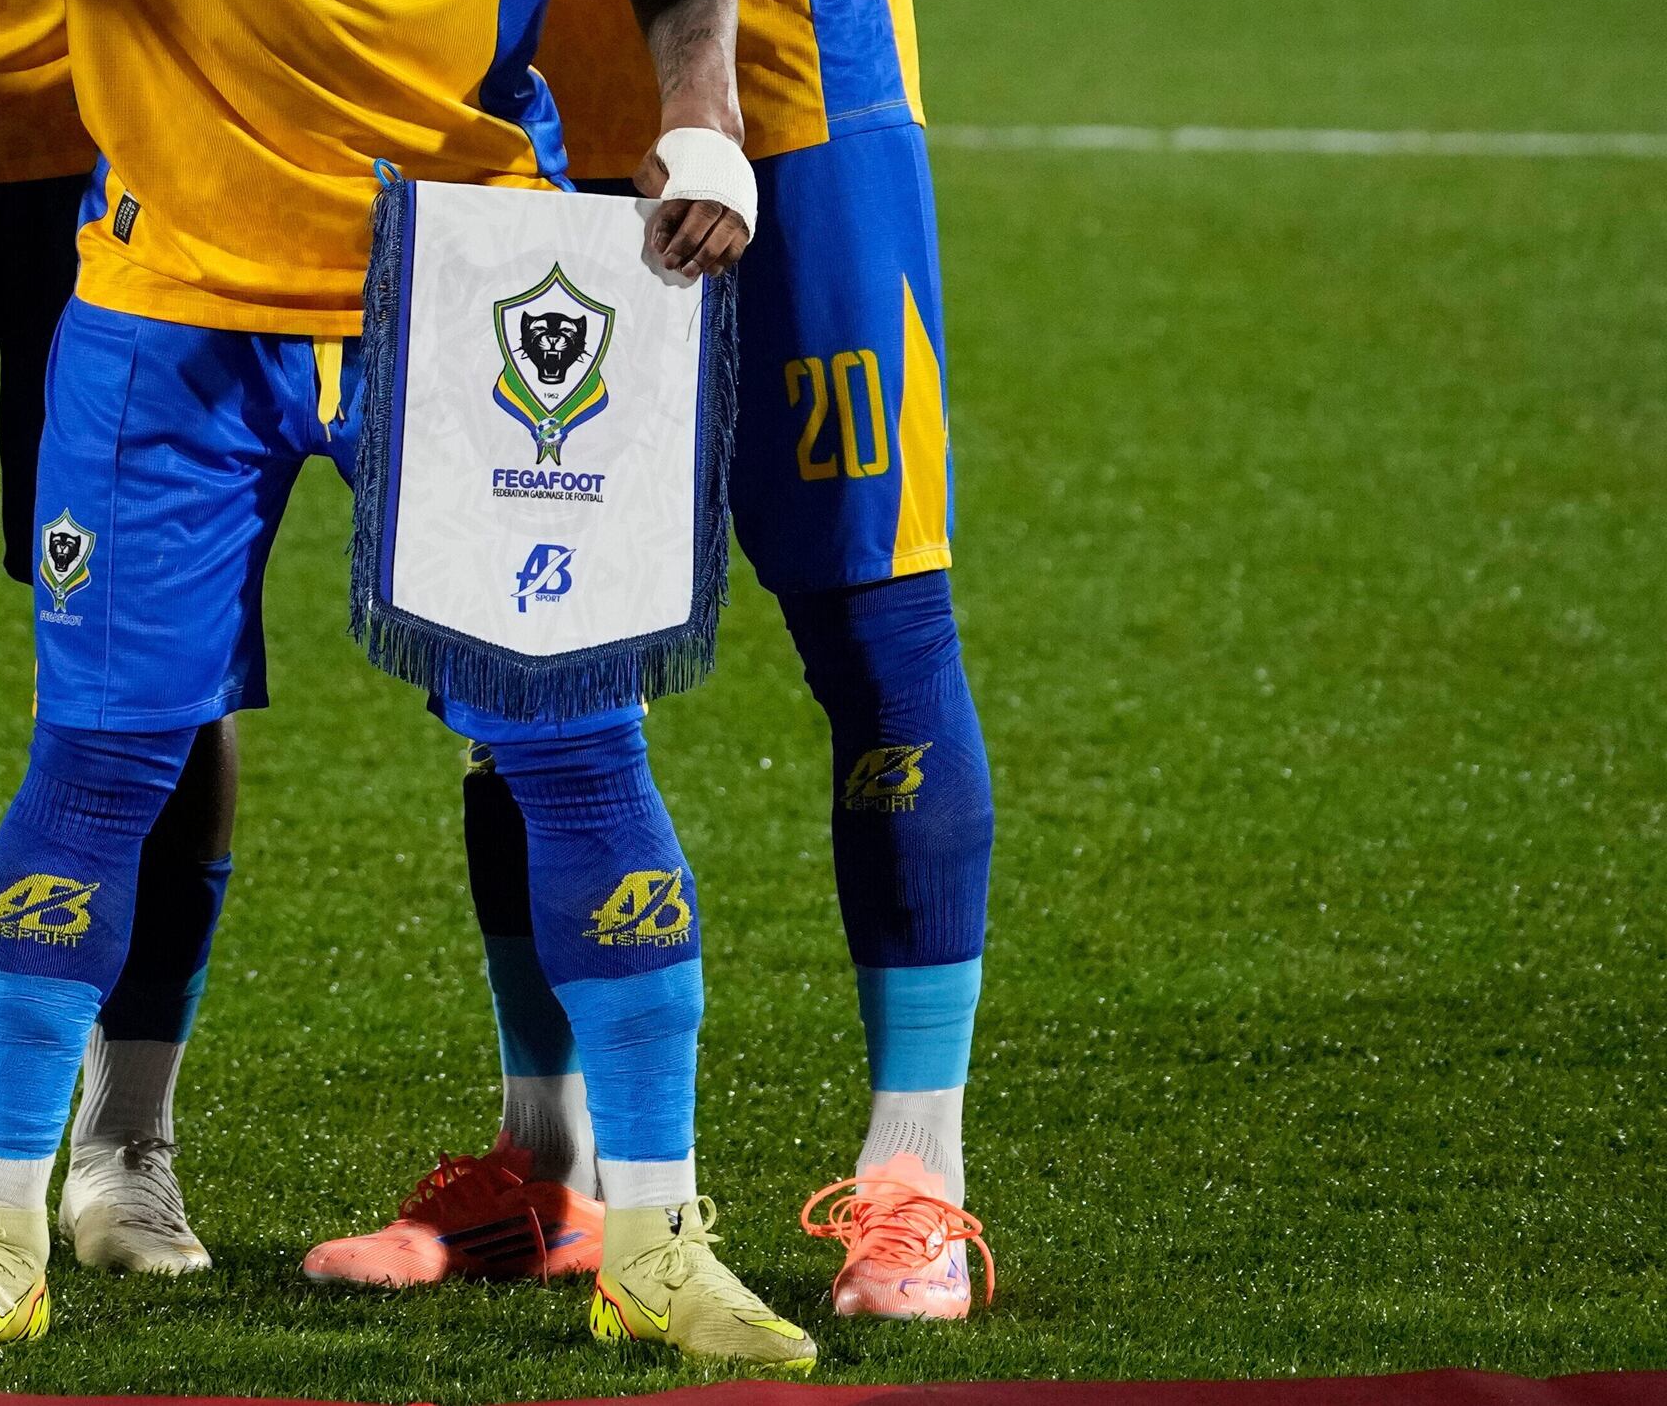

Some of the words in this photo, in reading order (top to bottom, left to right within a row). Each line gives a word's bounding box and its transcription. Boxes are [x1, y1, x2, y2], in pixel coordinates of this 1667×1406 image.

[784, 349, 890, 481] 20
[492, 469, 605, 493] FEGAFOOT
[493, 488, 529, 499] FEDERATION
[530, 489, 564, 500] GABONAISE
[565, 492, 573, 501] DE
[574, 493, 604, 503] FOOTBALL
[535, 595, 561, 603] SPORT
